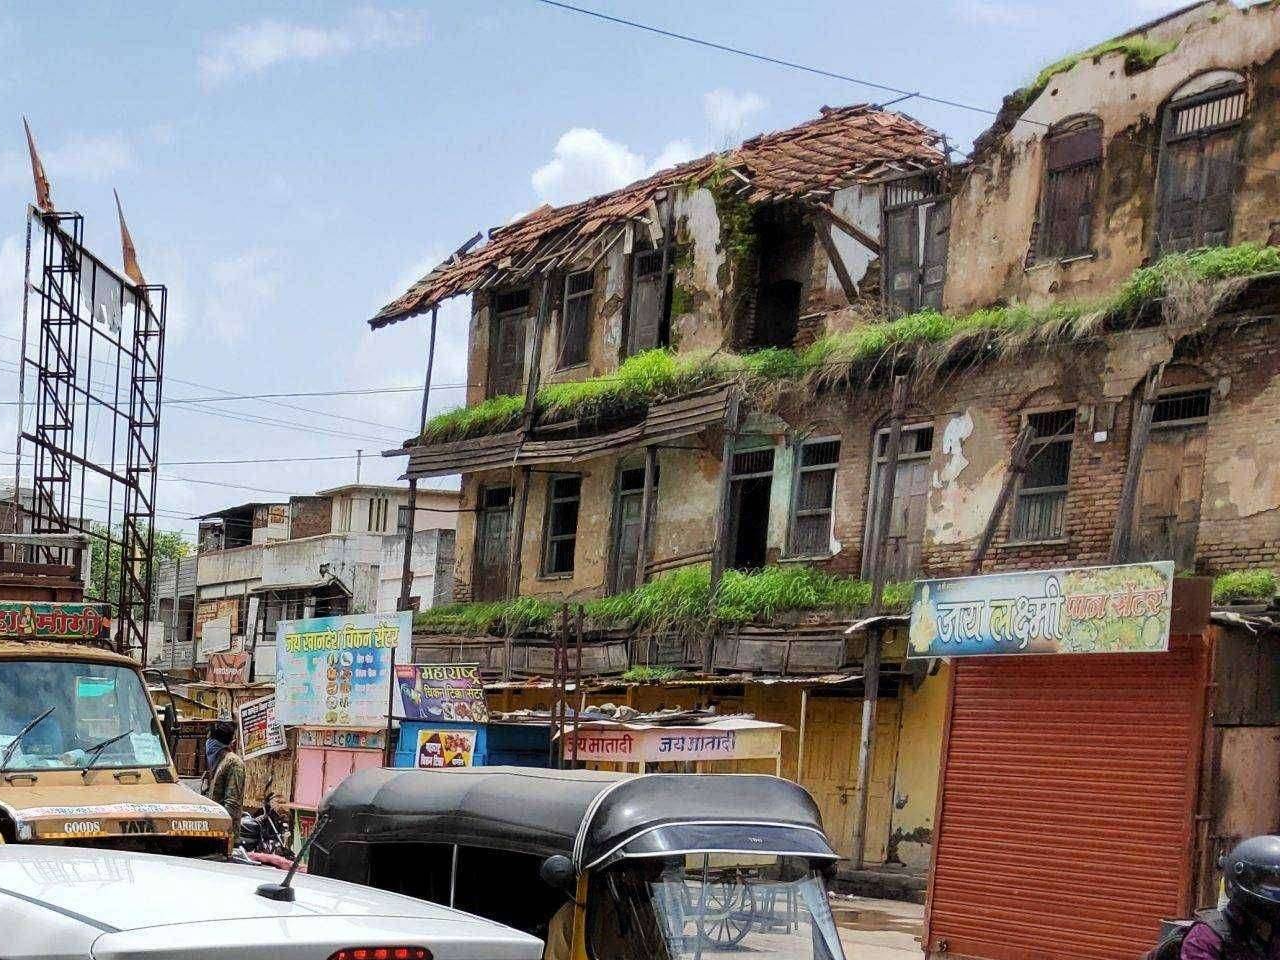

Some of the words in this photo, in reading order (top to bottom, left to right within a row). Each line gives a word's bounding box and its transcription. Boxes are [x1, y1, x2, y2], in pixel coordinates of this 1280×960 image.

[936, 601, 983, 643] जय
[989, 576, 1065, 649] लक्ष्मी
[1065, 594, 1106, 620] पान
[64, 821, 100, 833] GOODS
[171, 820, 209, 832] CARRIER
